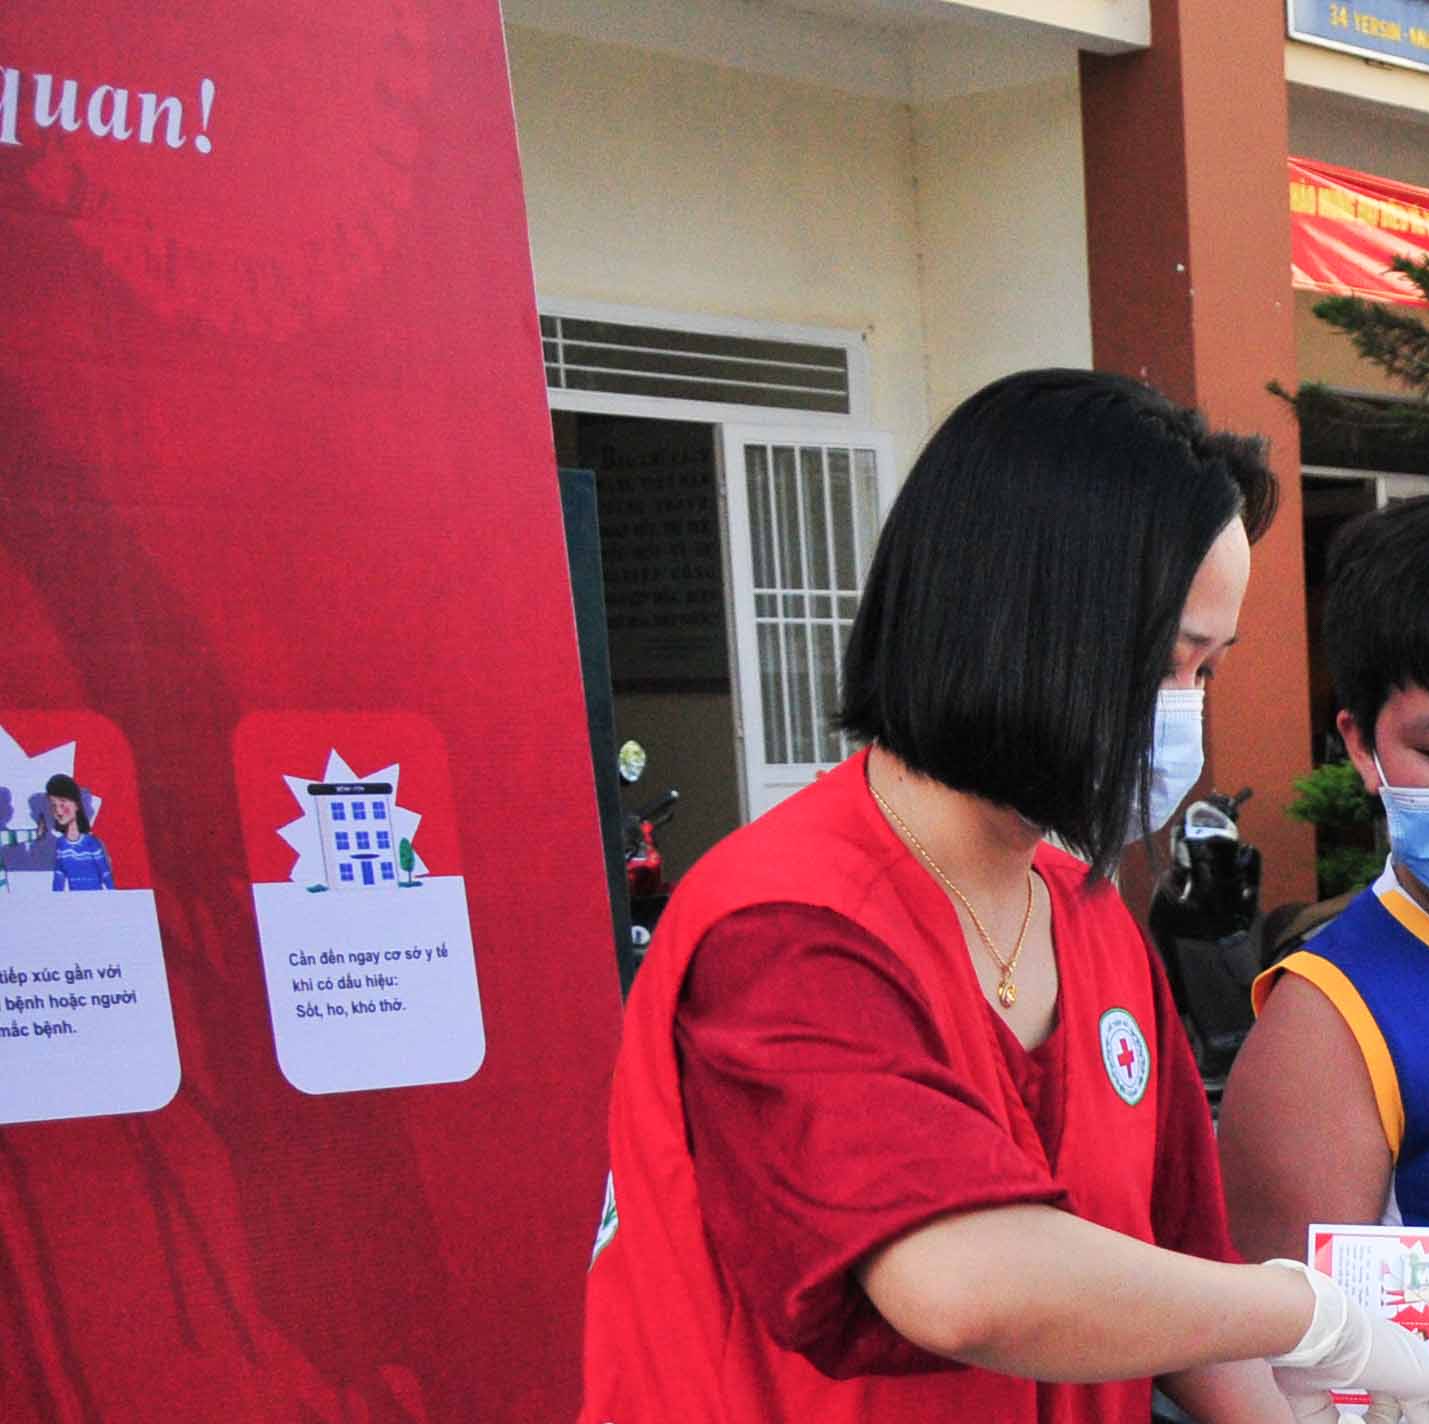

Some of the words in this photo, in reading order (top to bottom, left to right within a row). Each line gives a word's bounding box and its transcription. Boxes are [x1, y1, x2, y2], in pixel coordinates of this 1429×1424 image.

[289, 949, 316, 967] Cần
[319, 948, 345, 965] đến
[348, 950, 380, 966] ngay
[384, 949, 401, 961] cơ
[405, 945, 422, 961] sở
[425, 948, 433, 962] y
[436, 941, 449, 958] tế
[32, 967, 61, 982] xúc
[65, 962, 93, 984] gần
[97, 963, 123, 979] với
[292, 978, 314, 993] khi
[317, 976, 334, 991] có
[337, 972, 362, 990] dấu
[365, 973, 400, 991] hiệu:
[4, 994, 45, 1014] bệnh
[49, 993, 88, 1011] hoặc
[91, 990, 138, 1008] người
[295, 1002, 324, 1019] Sốt,
[327, 1003, 349, 1018] ho,
[351, 999, 377, 1015] khó
[379, 998, 407, 1012] thở.
[0, 1020, 30, 1038] mắc
[33, 1020, 77, 1039] bệnh.
